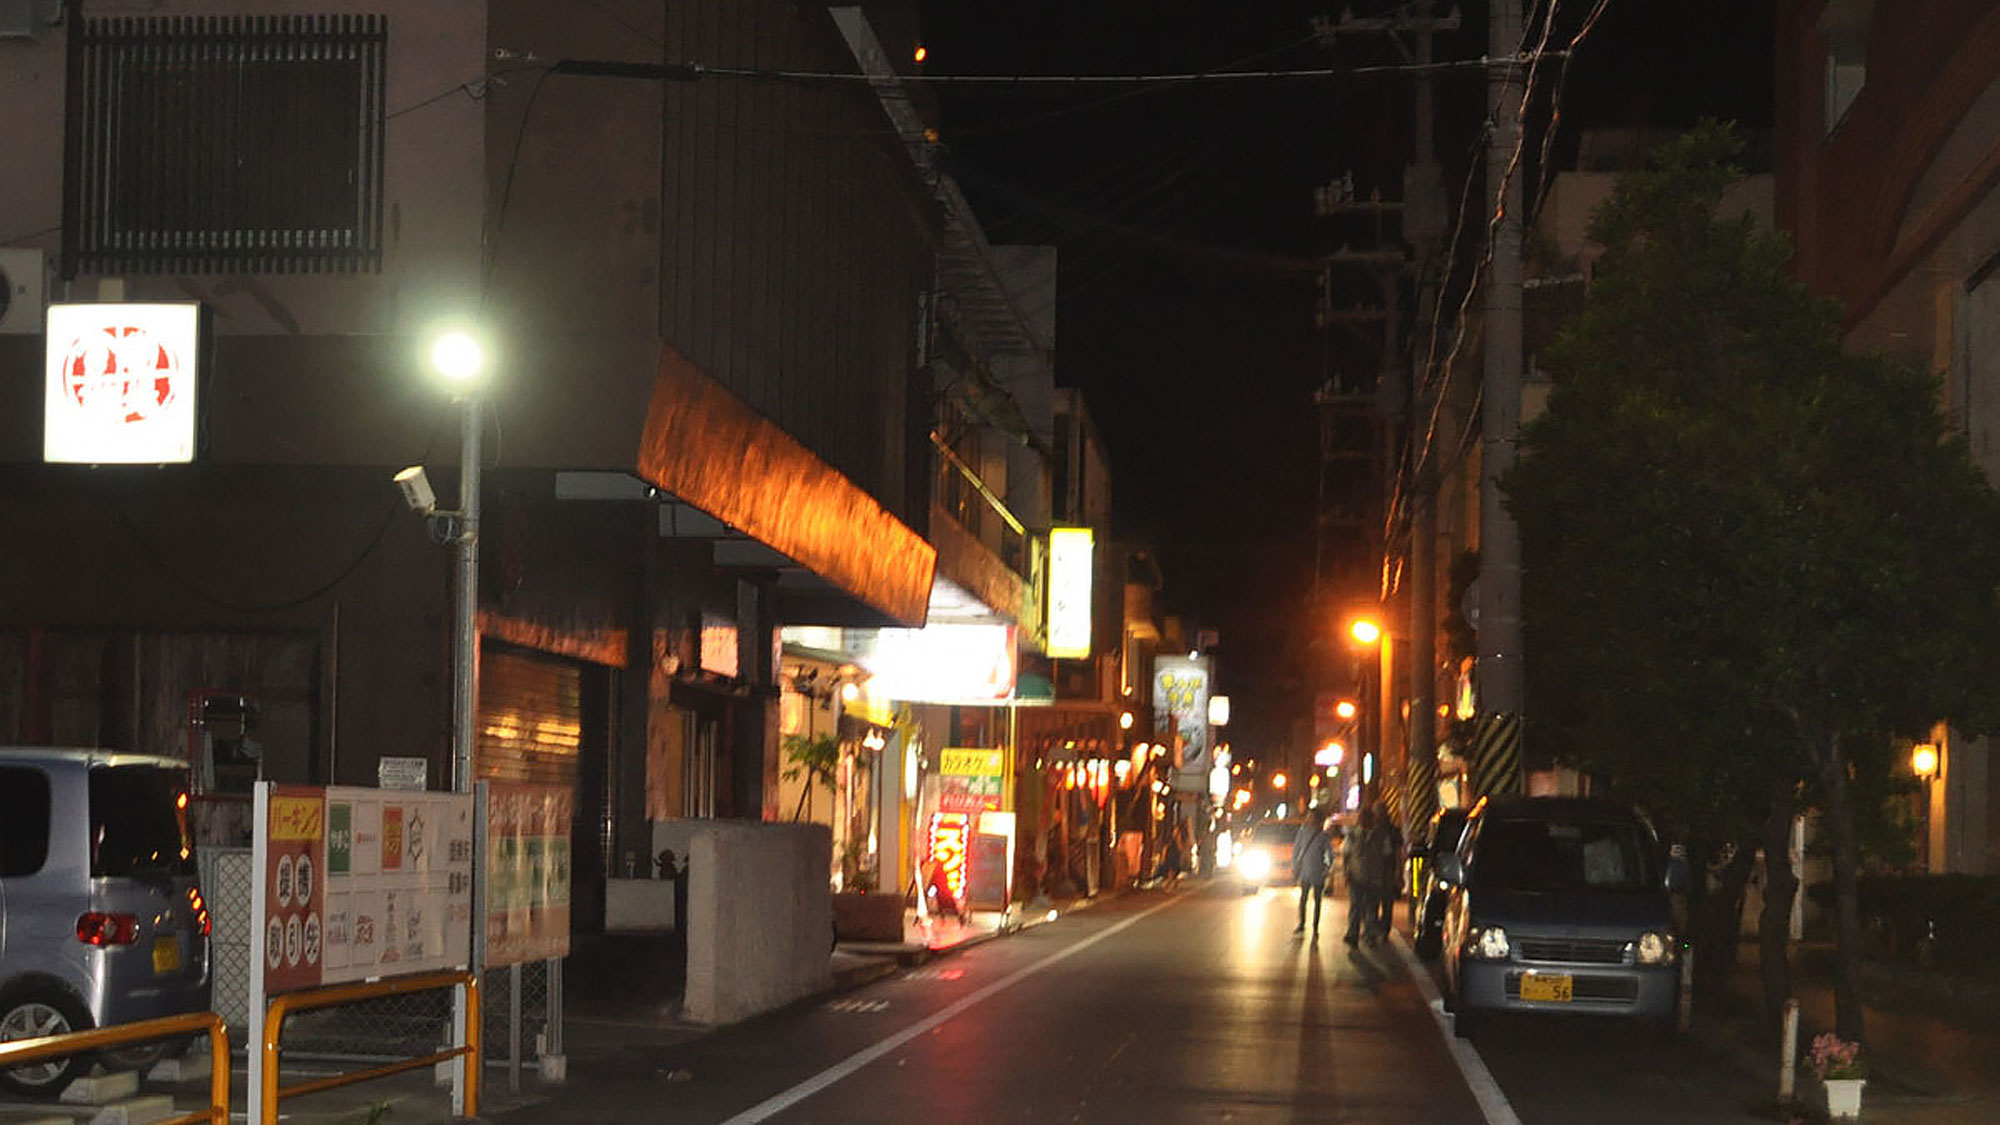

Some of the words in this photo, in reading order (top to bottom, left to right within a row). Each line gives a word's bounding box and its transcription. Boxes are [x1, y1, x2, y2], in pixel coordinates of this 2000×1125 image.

[272, 803, 321, 835] パーキング
[268, 919, 319, 959] 取引先
[1552, 984, 1571, 999] 56
